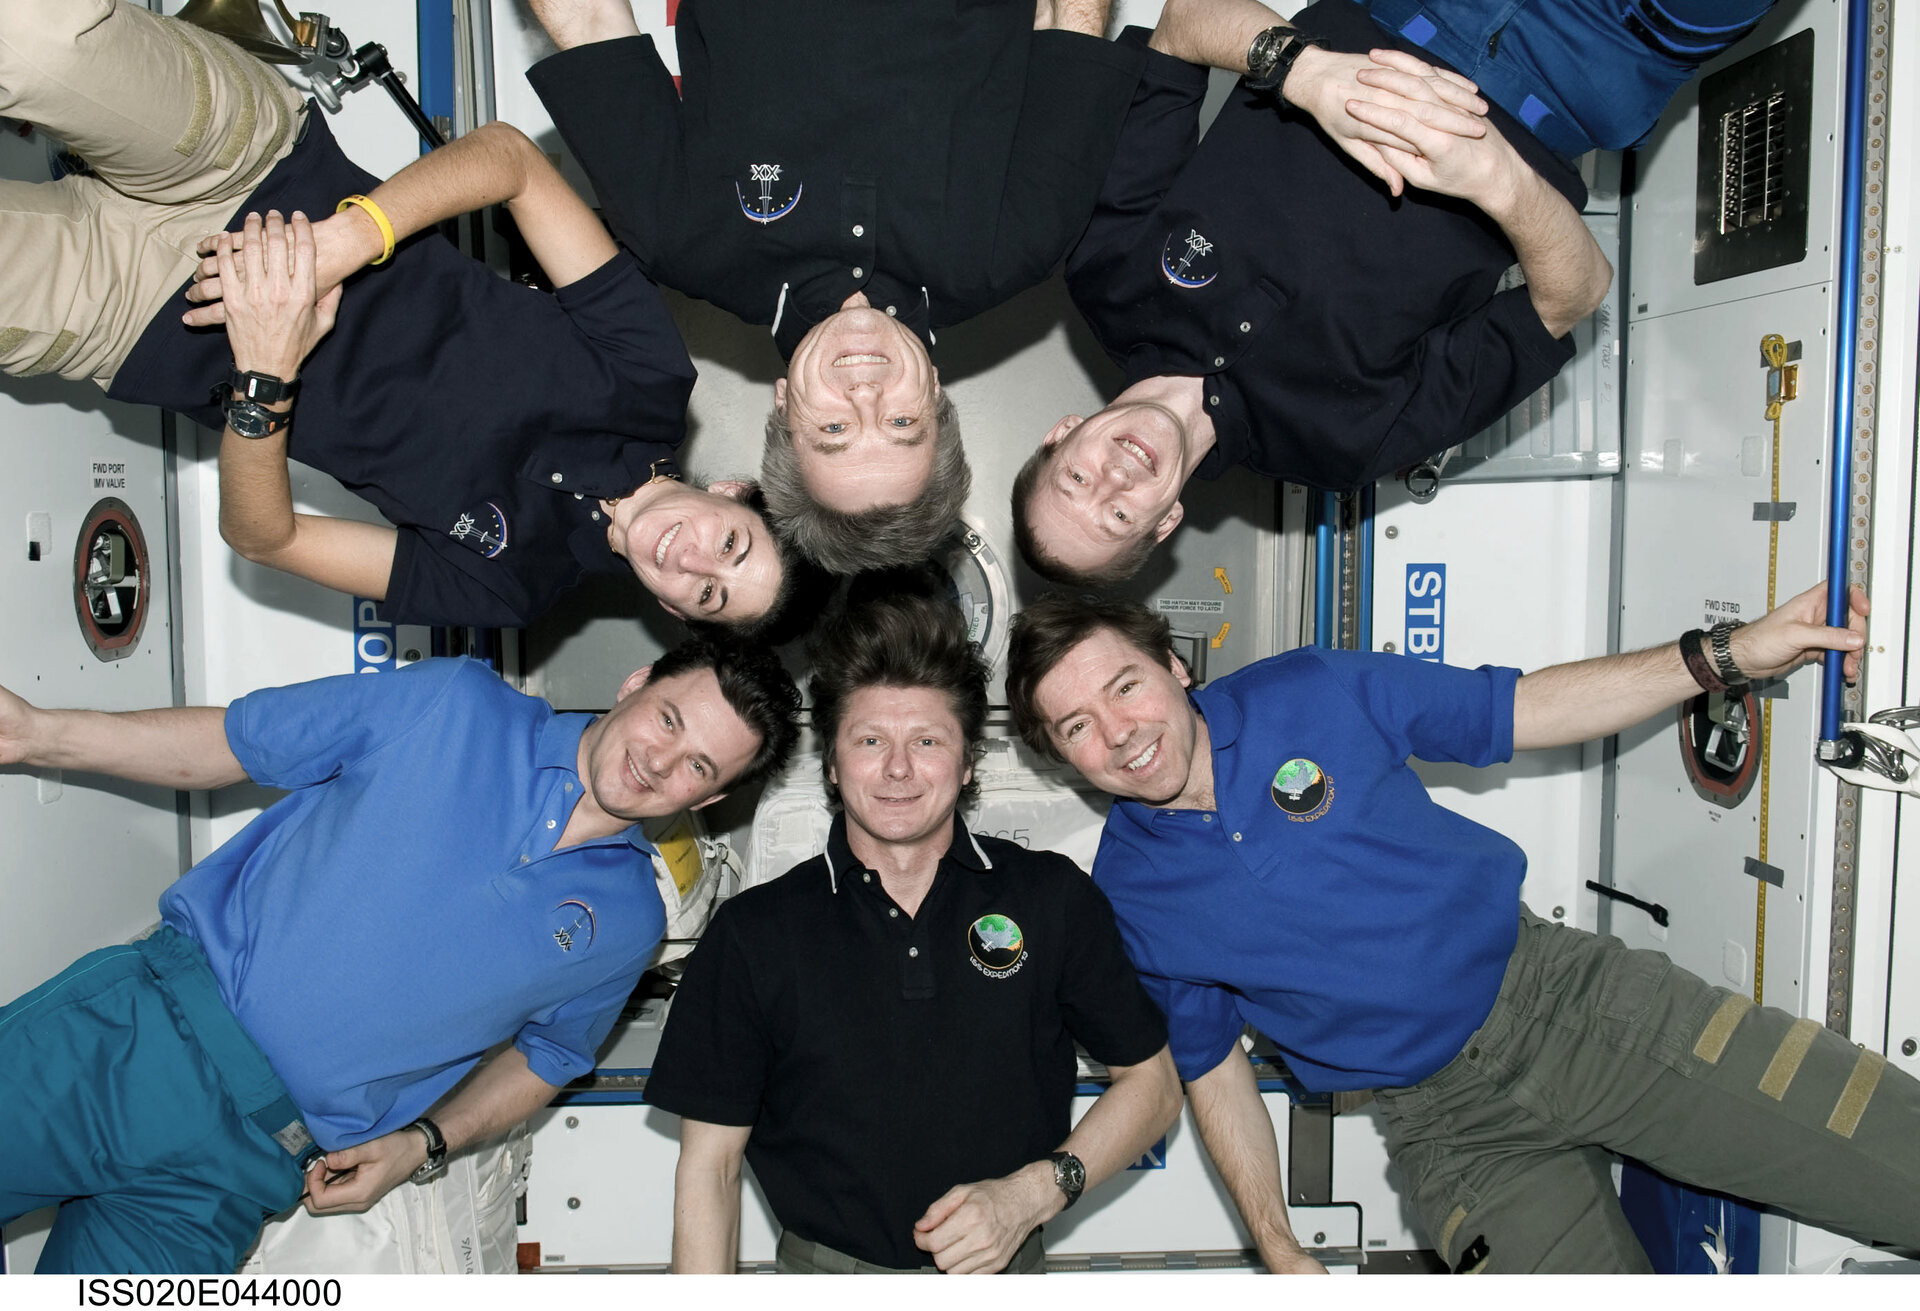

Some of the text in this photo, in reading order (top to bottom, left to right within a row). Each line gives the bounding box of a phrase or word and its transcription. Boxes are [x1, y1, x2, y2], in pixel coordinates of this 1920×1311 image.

[93, 463, 125, 473] FWD PORT
[106, 478, 125, 488] VALVE
[1705, 599, 1740, 613] FWD STBD
[1408, 571, 1442, 663] STB
[982, 960, 1023, 979] EXPEDITION
